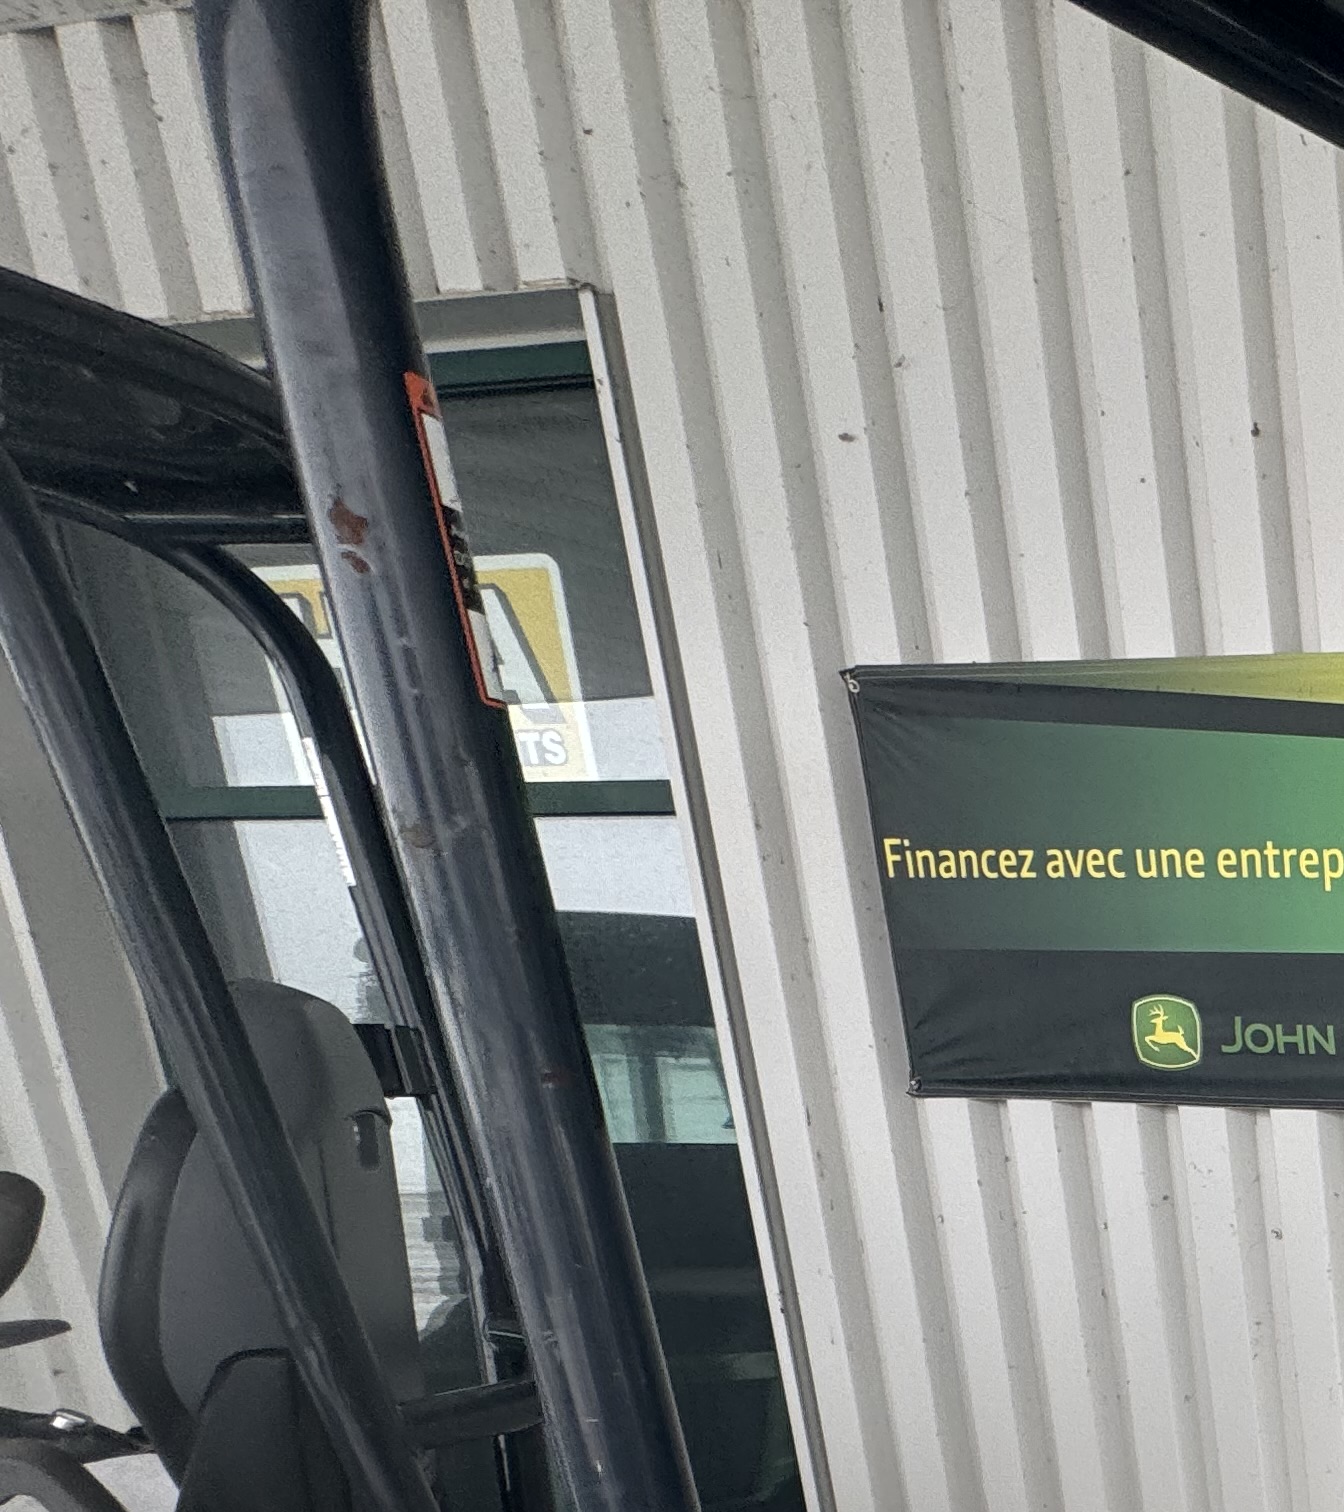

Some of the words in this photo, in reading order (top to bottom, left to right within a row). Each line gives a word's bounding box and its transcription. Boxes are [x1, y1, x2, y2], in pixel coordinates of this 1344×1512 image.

[883, 838, 1036, 878] Financez
[1047, 850, 1125, 879] avec
[1137, 853, 1205, 879] une
[1221, 1016, 1336, 1055] JOHN
